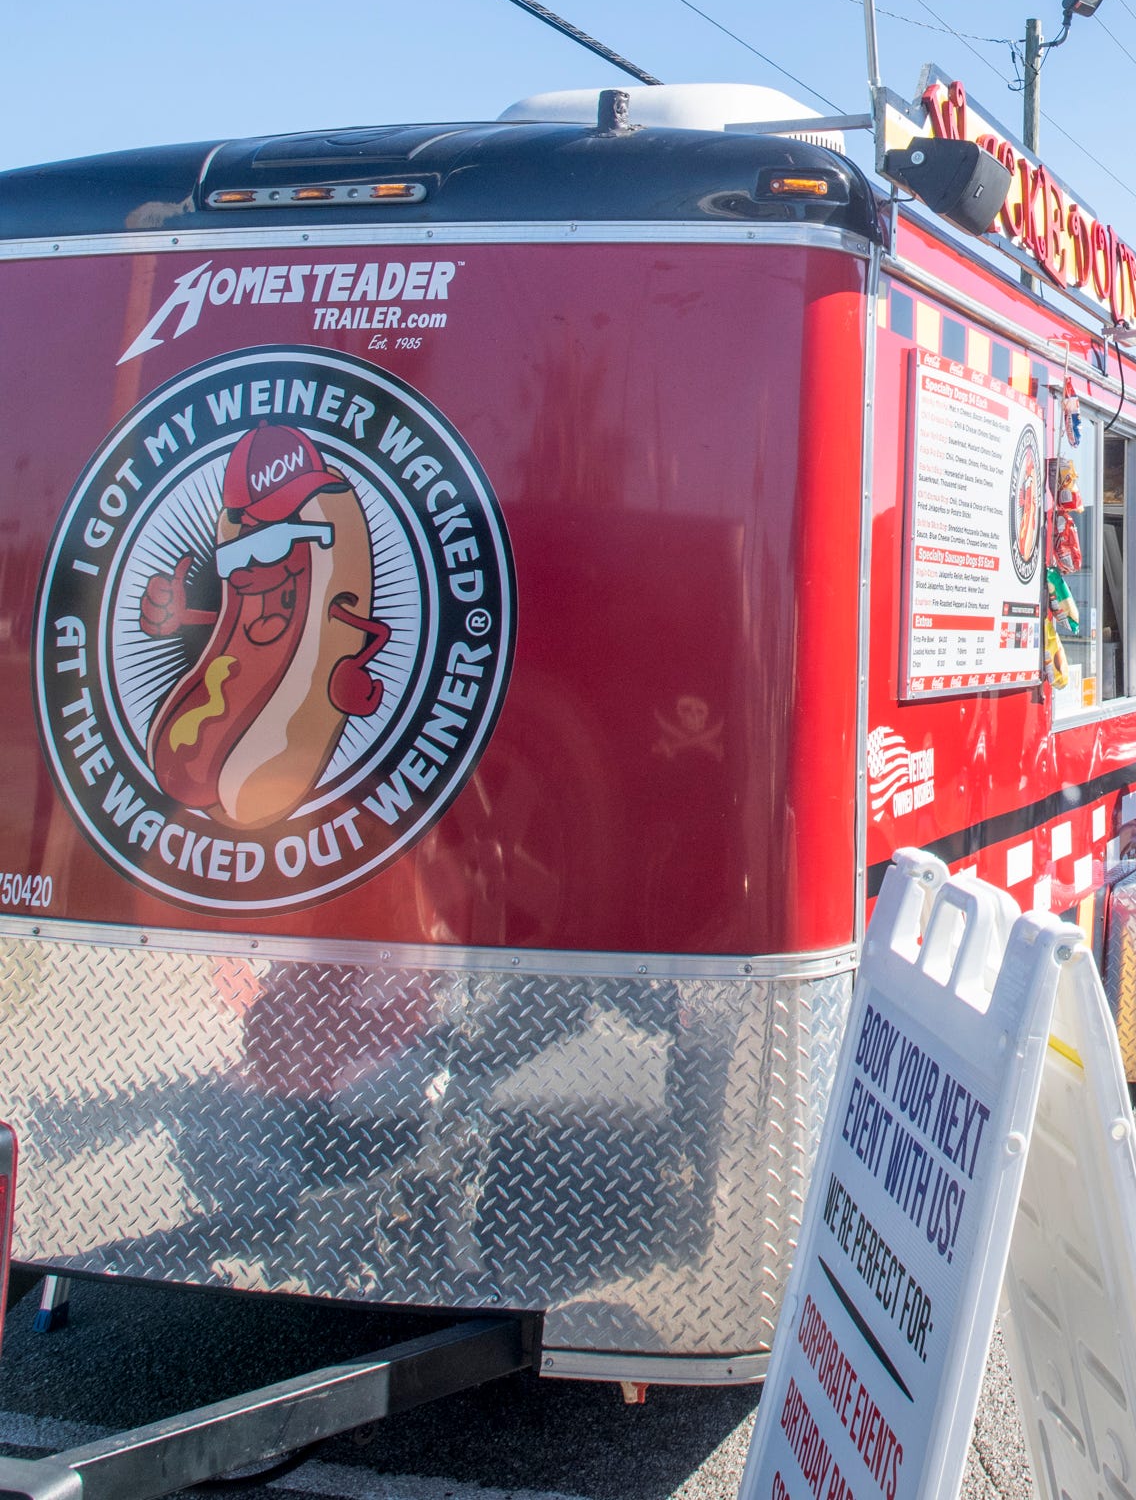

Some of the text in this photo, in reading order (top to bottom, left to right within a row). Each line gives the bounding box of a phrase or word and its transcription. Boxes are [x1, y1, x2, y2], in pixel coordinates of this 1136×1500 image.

[116, 260, 457, 366] HOMESTEADER
[312, 308, 448, 330] TRAILER.com
[367, 336, 422, 351] Est. 1985
[925, 379, 953, 398] Specialty
[73, 378, 484, 600] I GOT MY WEINER WACKED
[250, 445, 305, 494] WOW
[918, 547, 945, 564] Specialty
[945, 552, 965, 566] Sausage
[965, 554, 978, 568] Dogs
[915, 615, 933, 628] Extras
[54, 615, 492, 884] AT THE WACKED OUT WEINER
[855, 1003, 991, 1180] BOOK YOUR NEXT
[842, 1077, 967, 1265] EVENT WITH US!
[823, 1172, 934, 1364] WE'RE PERFECT FOR:
[780, 1376, 833, 1500] BIRTHDAY
[798, 1294, 858, 1428] CORPORATE
[849, 1383, 904, 1500] EVENTS
